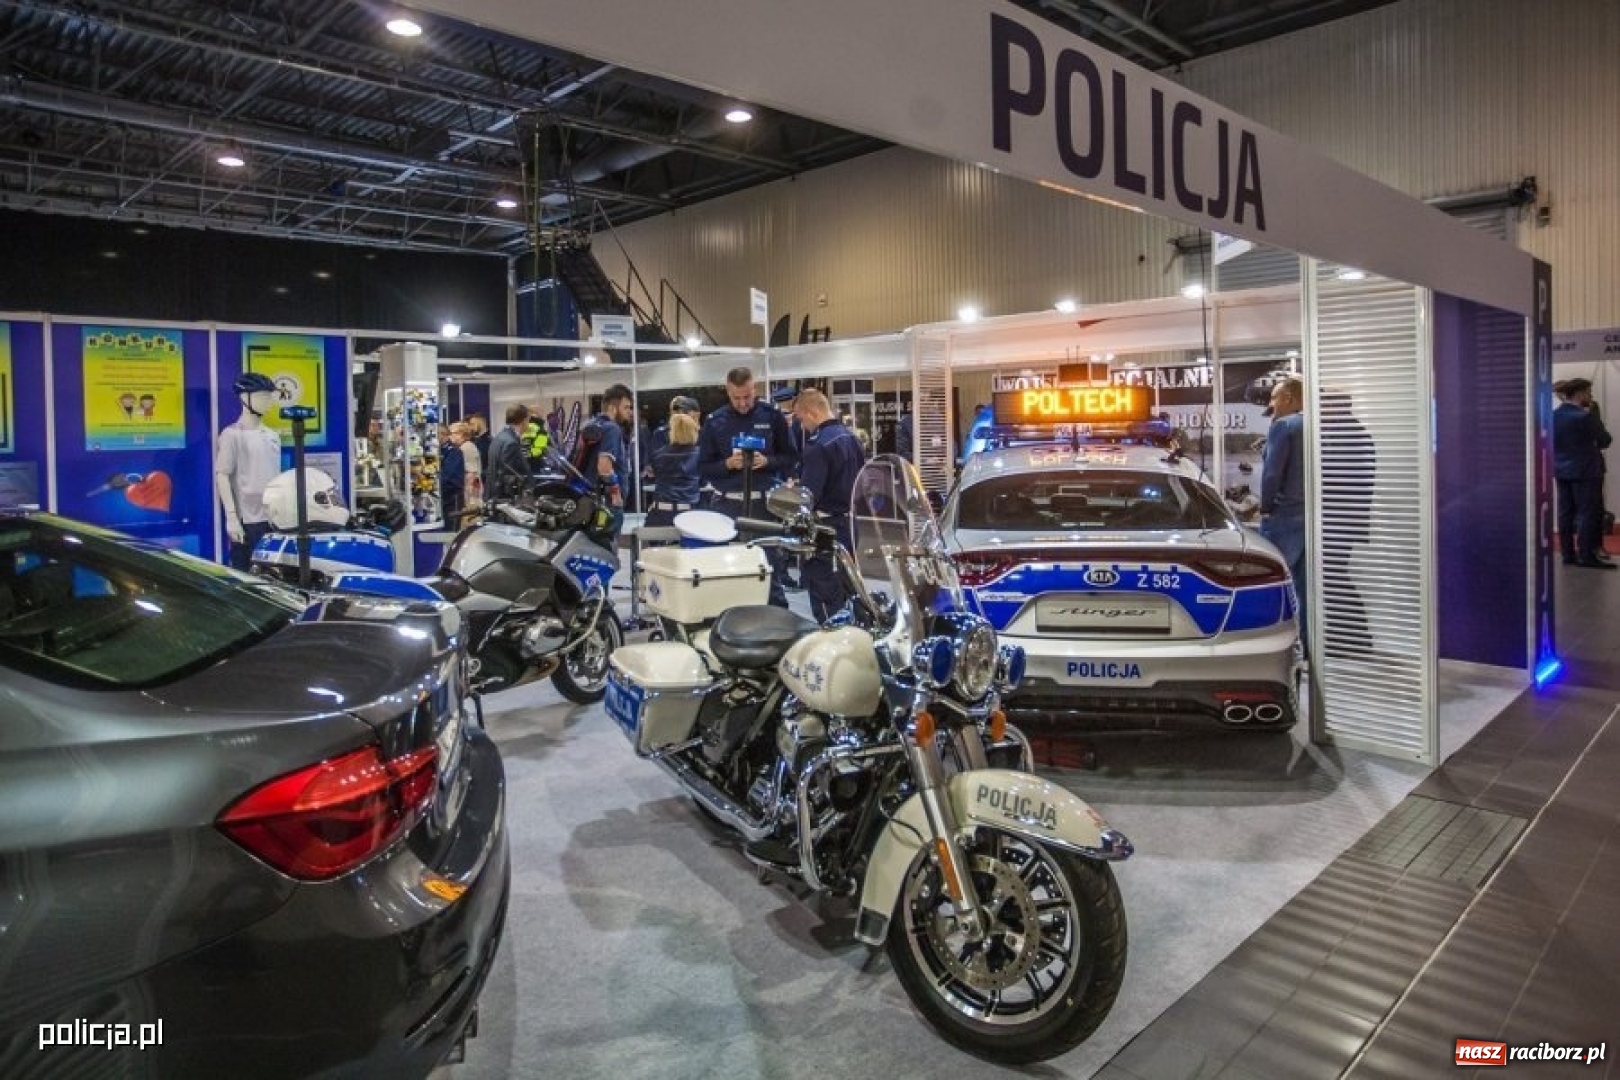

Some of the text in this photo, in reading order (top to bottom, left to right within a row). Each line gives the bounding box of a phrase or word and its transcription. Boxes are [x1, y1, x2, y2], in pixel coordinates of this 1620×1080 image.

[991, 12, 1266, 231] POLICJA
[1022, 388, 1132, 416] POLTECH
[1089, 570, 1114, 583] KIA
[1137, 573, 1180, 589] Z 582
[1050, 605, 1157, 619] stinger
[1067, 662, 1142, 679] POLICJA
[977, 784, 1057, 826] POLICJA
